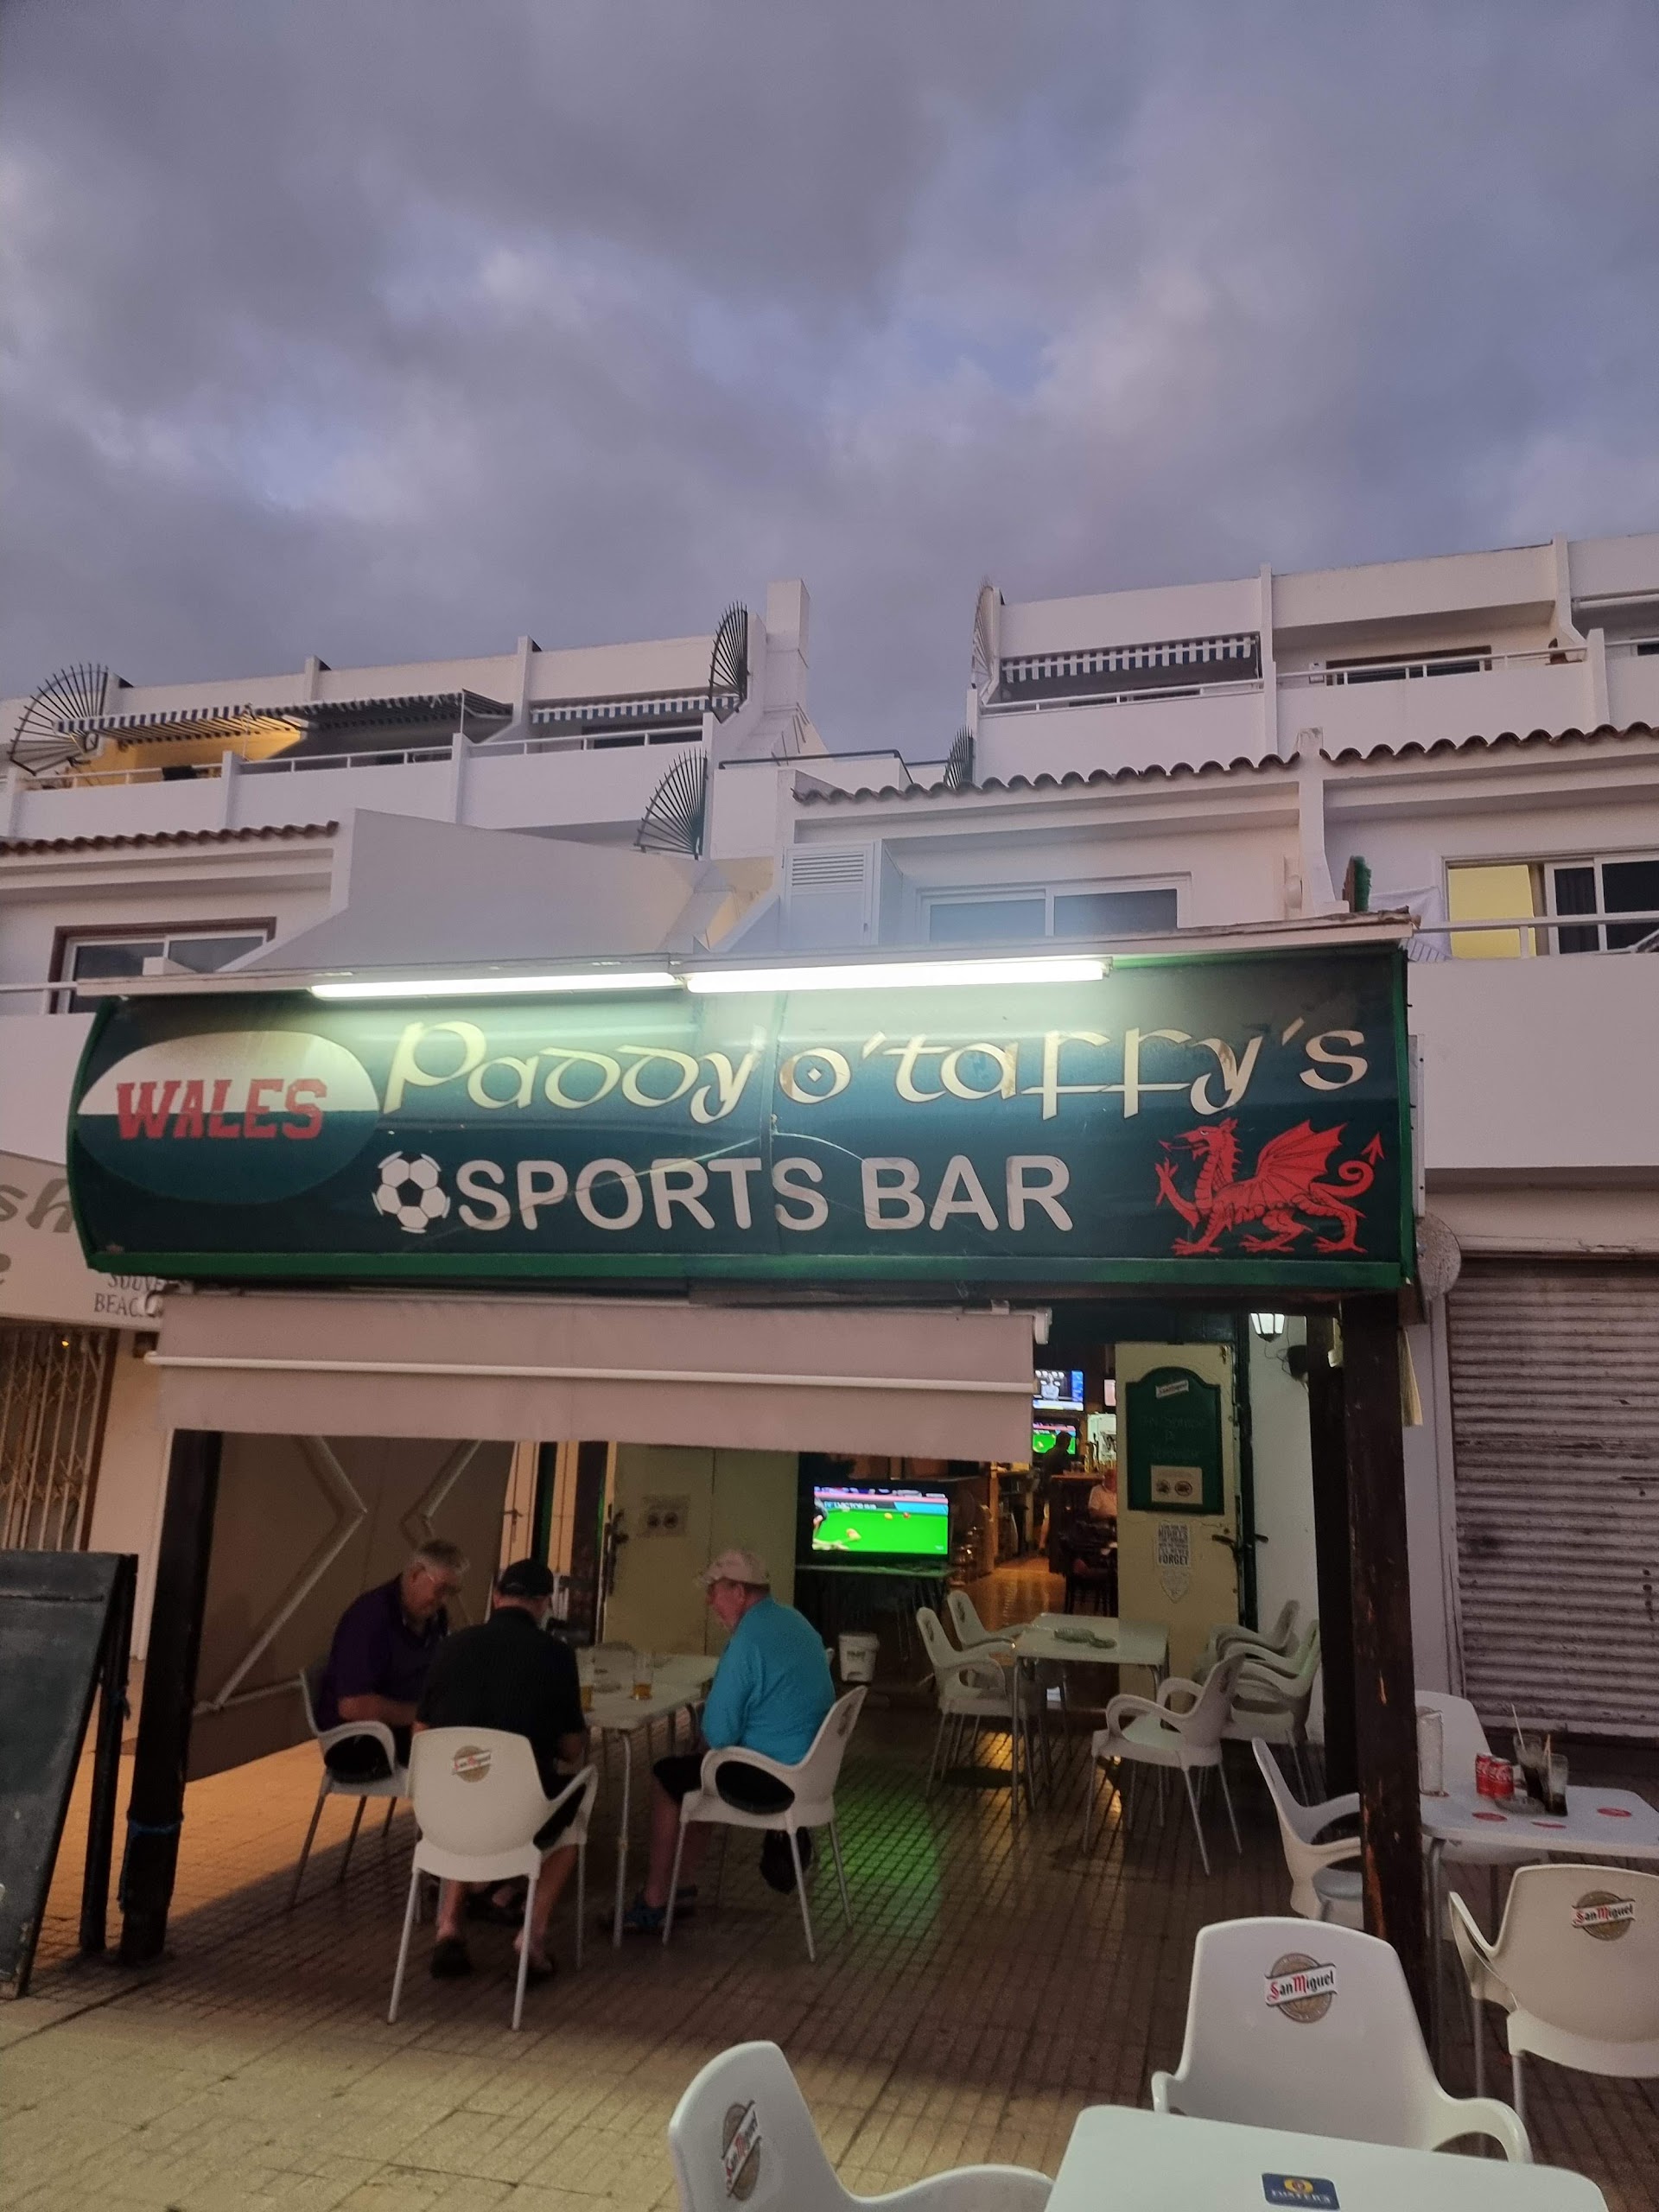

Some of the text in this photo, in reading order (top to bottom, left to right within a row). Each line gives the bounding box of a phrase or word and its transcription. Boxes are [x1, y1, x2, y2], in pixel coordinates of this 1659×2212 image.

[116, 1077, 327, 1140] WALES
[382, 1020, 766, 1125] Paddy
[456, 1154, 1074, 1232] SPORTS BAR
